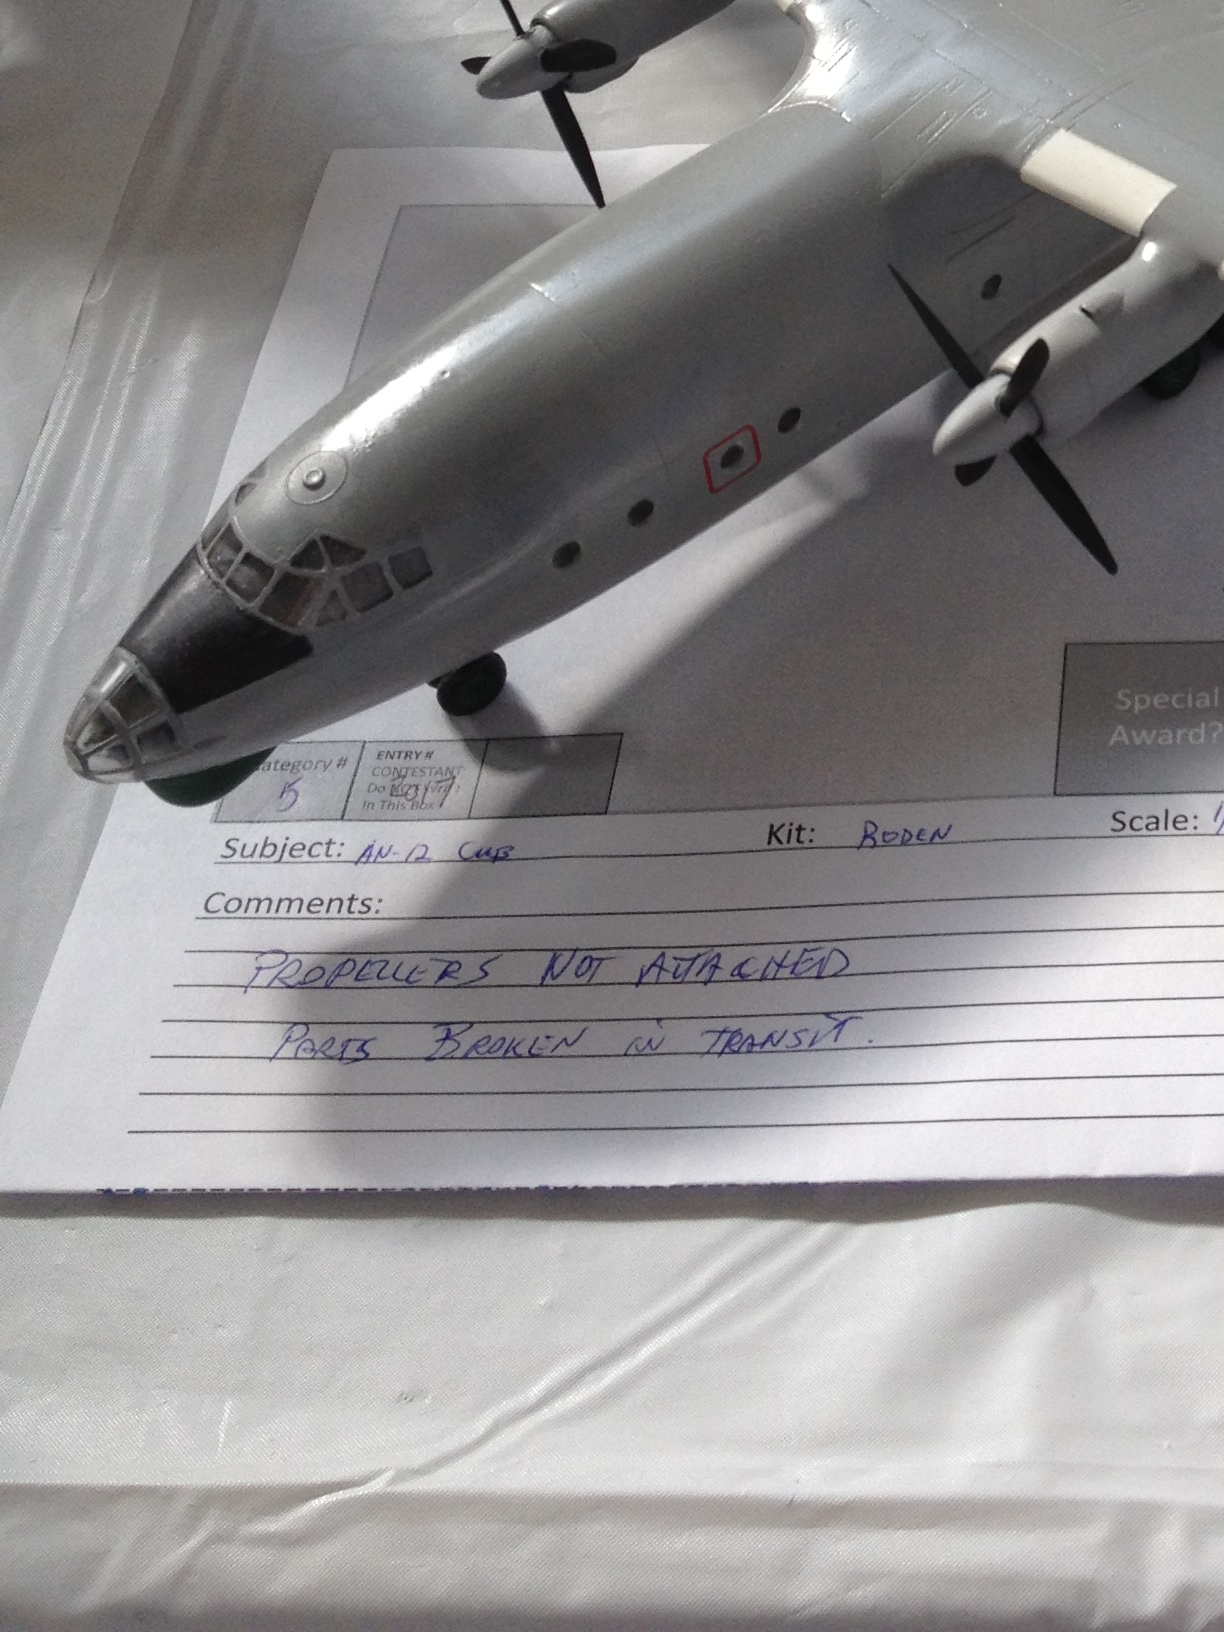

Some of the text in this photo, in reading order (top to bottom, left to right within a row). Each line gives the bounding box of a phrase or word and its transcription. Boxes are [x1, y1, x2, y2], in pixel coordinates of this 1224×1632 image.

[1114, 686, 1220, 712] Special
[1108, 722, 1224, 747] Award?
[256, 758, 333, 775] ategory
[376, 750, 422, 761] ENTRY
[276, 776, 304, 813] 5
[367, 783, 385, 794] Do
[362, 800, 375, 810] In
[381, 800, 406, 811] This
[1110, 808, 1199, 834] Scale:
[766, 822, 815, 846] Kit:
[220, 836, 345, 863] Subject:
[203, 891, 384, 915] Comments:
[539, 947, 617, 986] NOT
